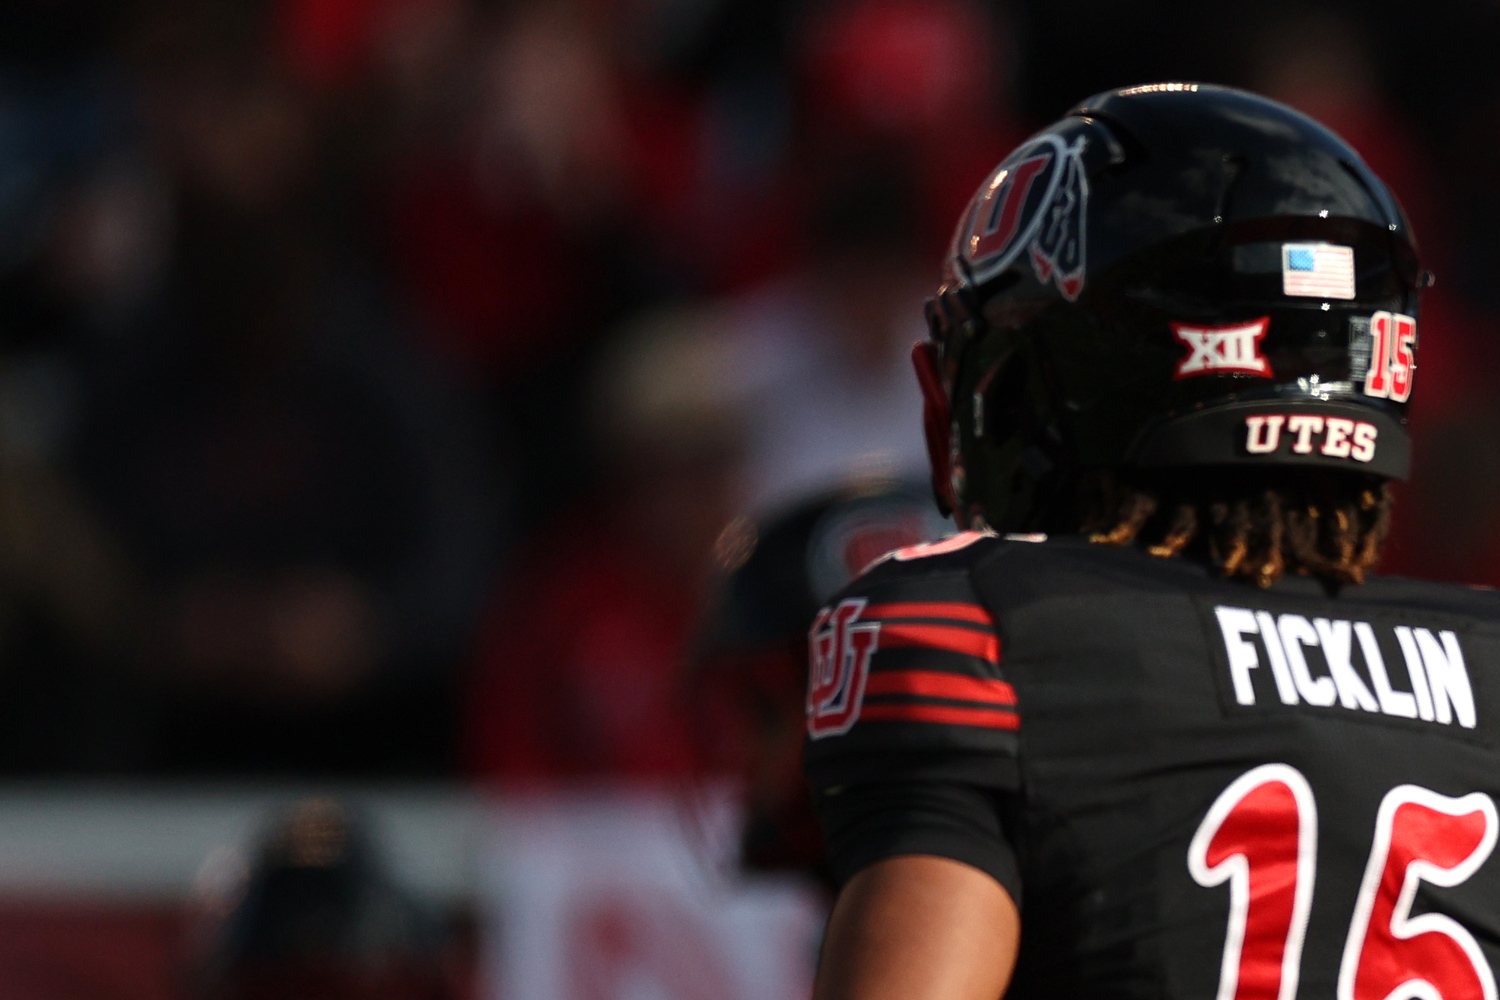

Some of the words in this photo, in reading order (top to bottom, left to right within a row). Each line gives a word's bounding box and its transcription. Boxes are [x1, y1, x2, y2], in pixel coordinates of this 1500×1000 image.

[1173, 319, 1270, 379] XII
[1364, 310, 1417, 404] 15
[1246, 414, 1378, 463] UTES
[1215, 605, 1478, 729] FICKLIN
